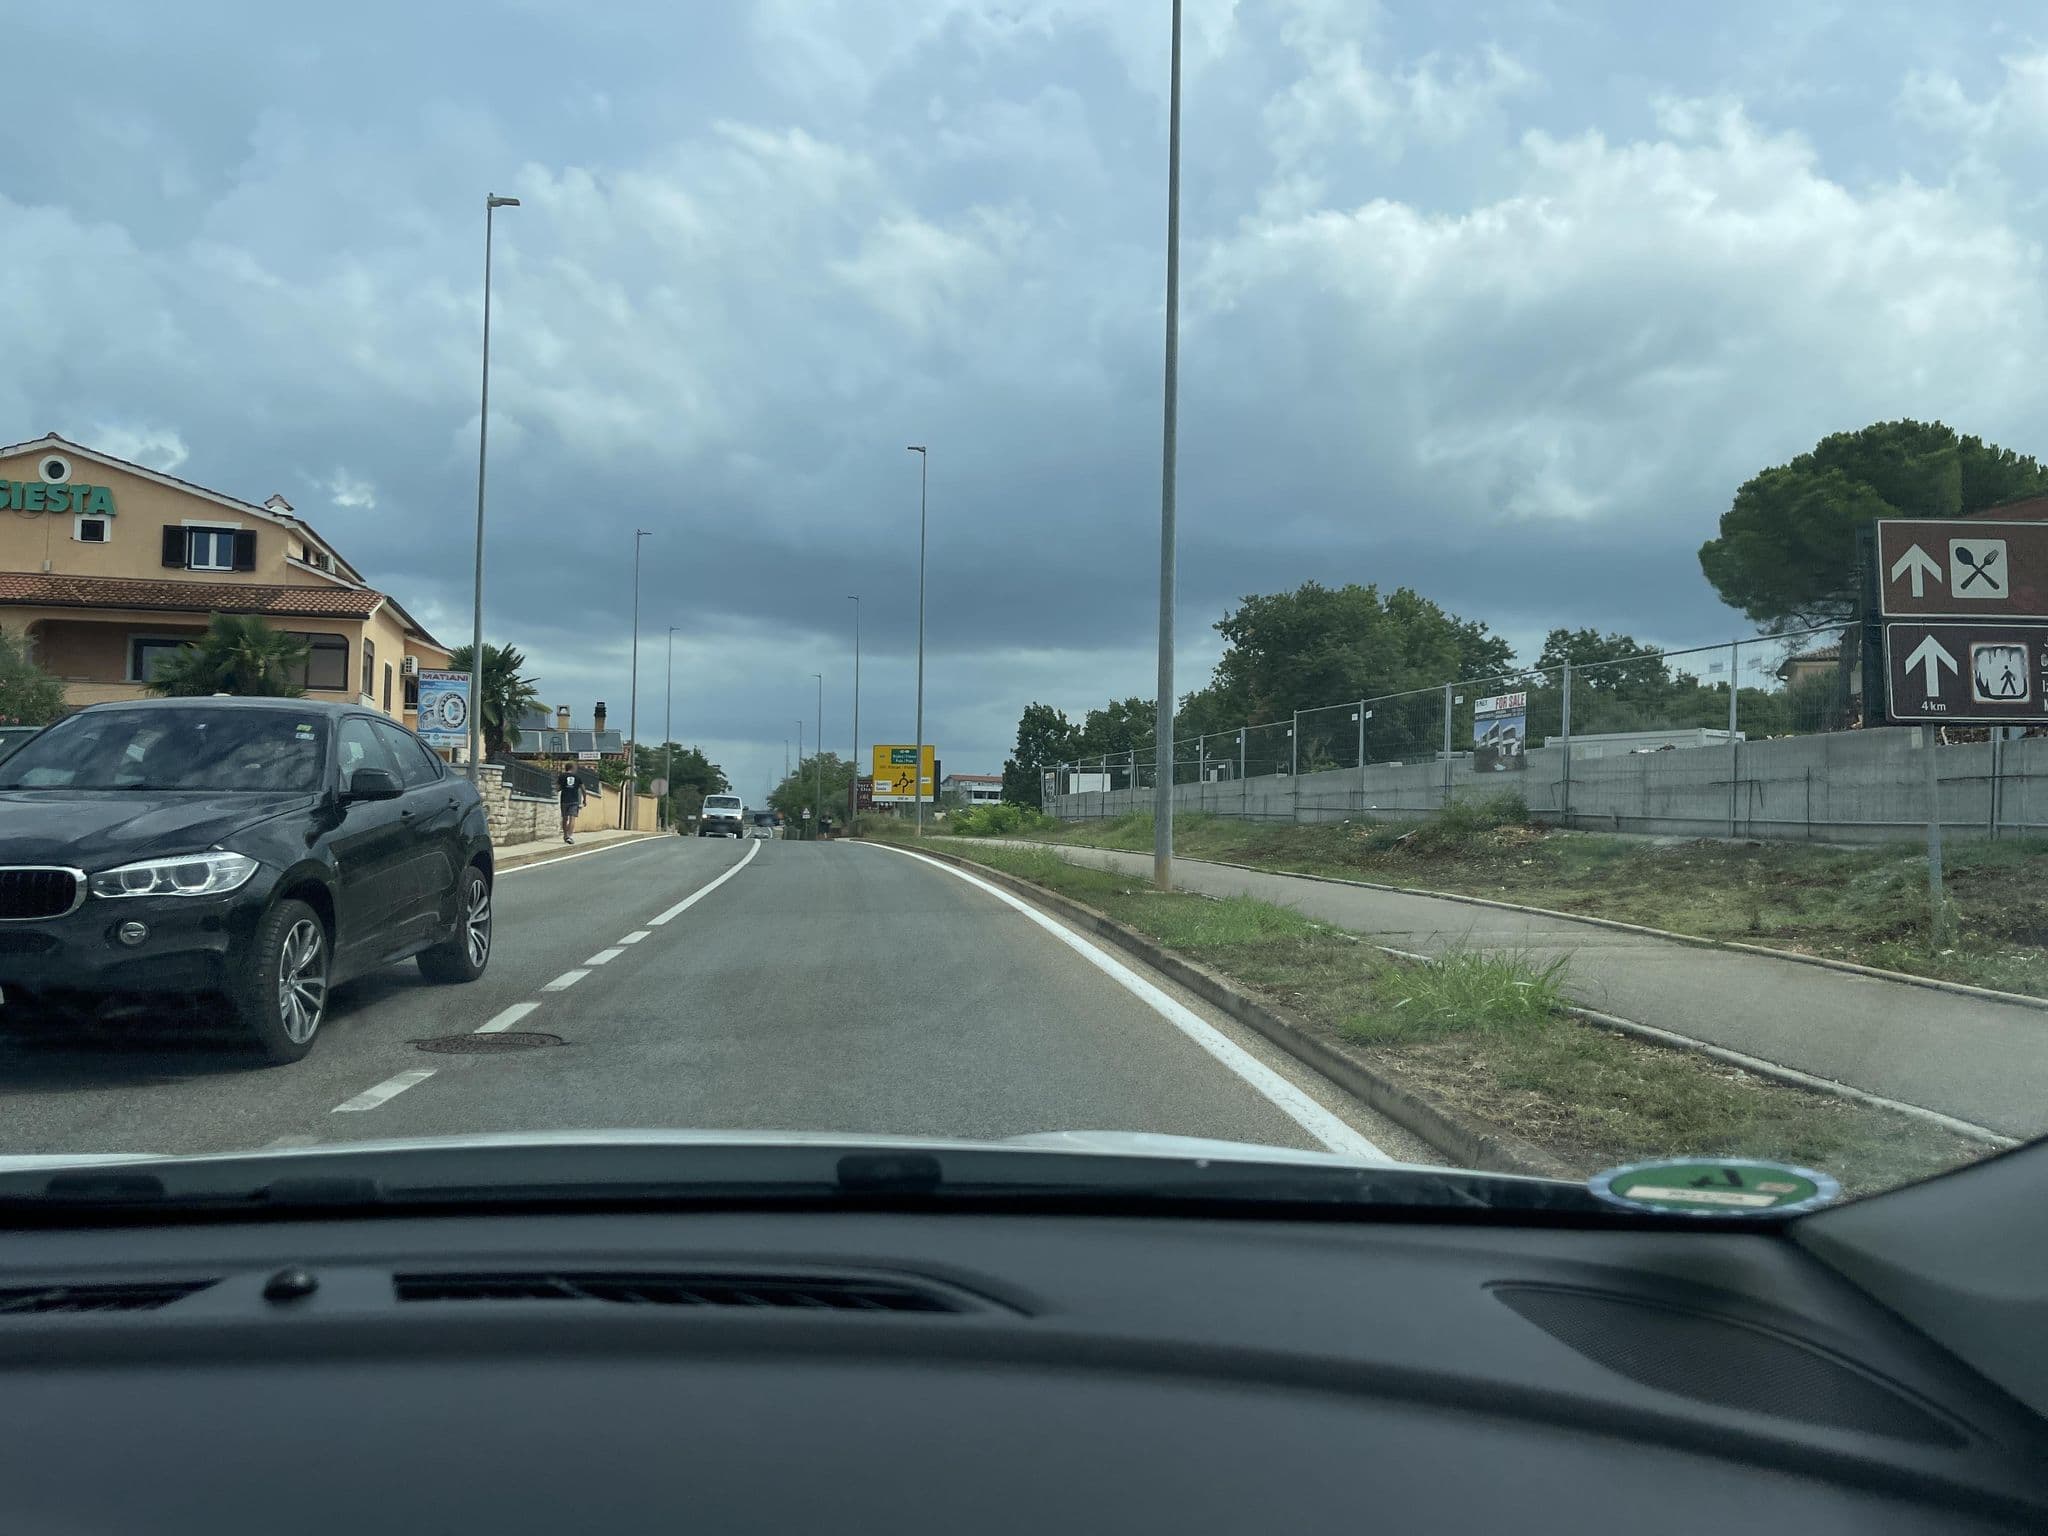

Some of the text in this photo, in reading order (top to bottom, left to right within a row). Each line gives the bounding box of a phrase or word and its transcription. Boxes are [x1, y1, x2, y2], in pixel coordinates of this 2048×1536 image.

[422, 673, 468, 681] MATIANI
[1496, 697, 1508, 709] FOR
[1509, 693, 1525, 707] SALE
[1921, 701, 1946, 711] 4 km
